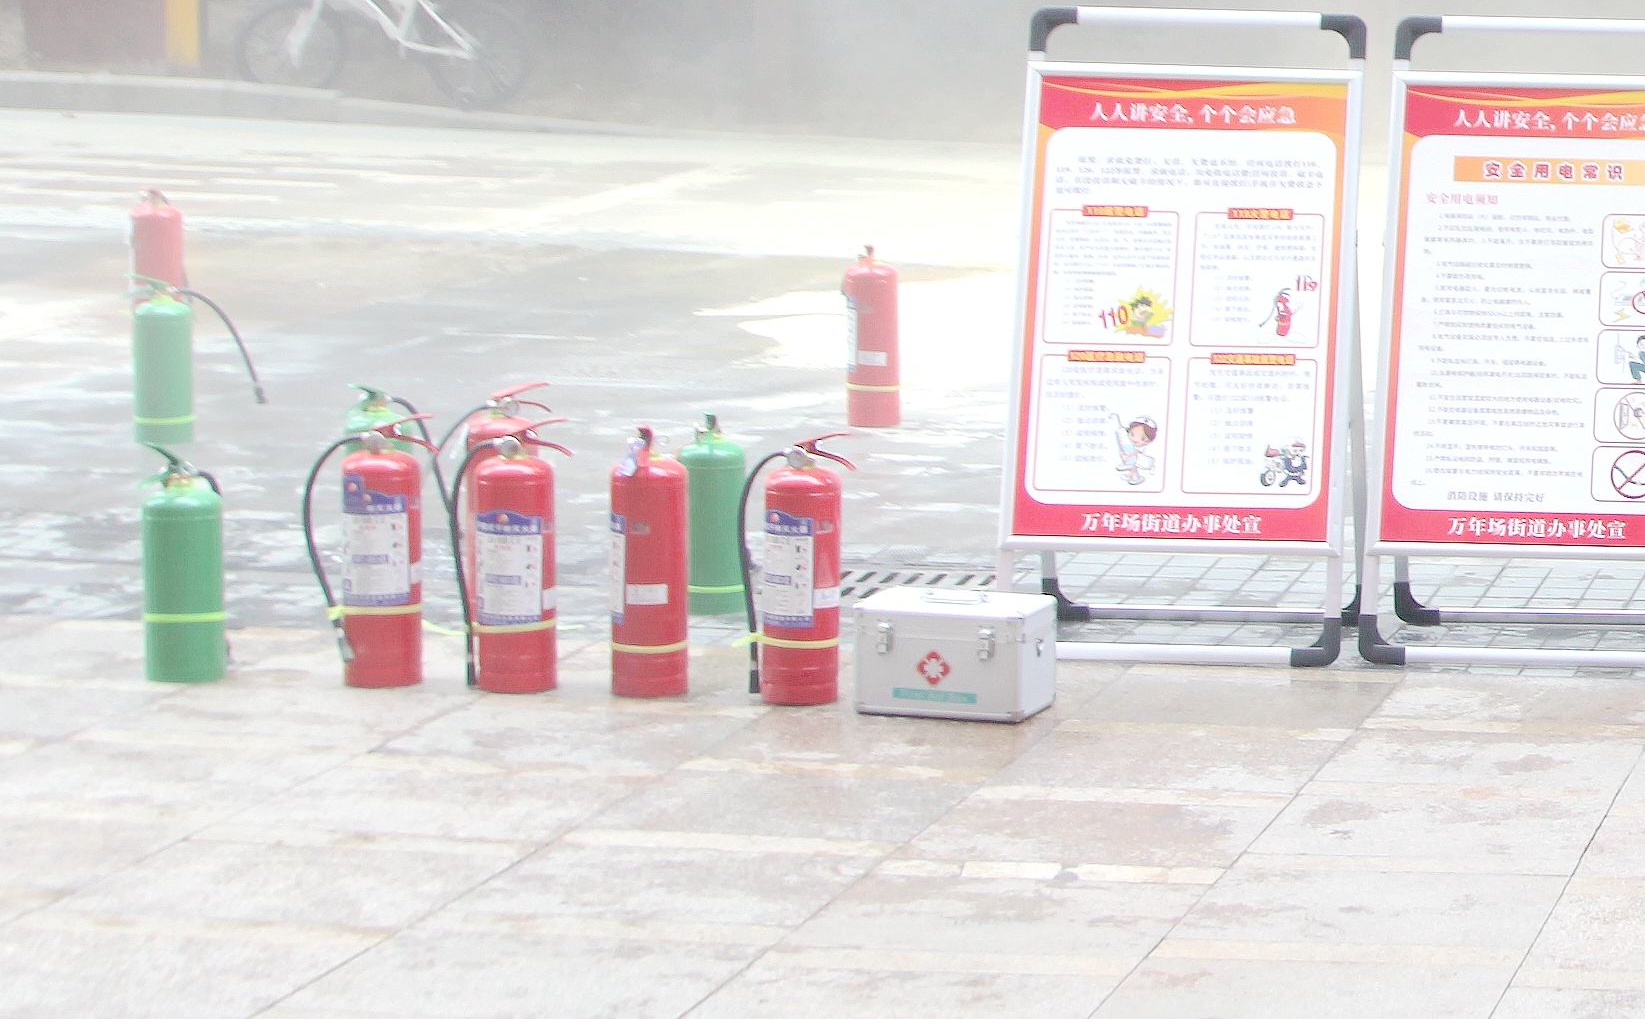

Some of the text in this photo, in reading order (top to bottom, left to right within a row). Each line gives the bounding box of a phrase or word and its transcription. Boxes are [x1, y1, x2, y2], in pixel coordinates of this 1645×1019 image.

[1484, 161, 1626, 182] 安全用电常识
[1098, 304, 1130, 330] 110
[1080, 512, 1262, 535] 万年场街道办事处宣
[1446, 516, 1627, 540] 万年场街道办事处宣
